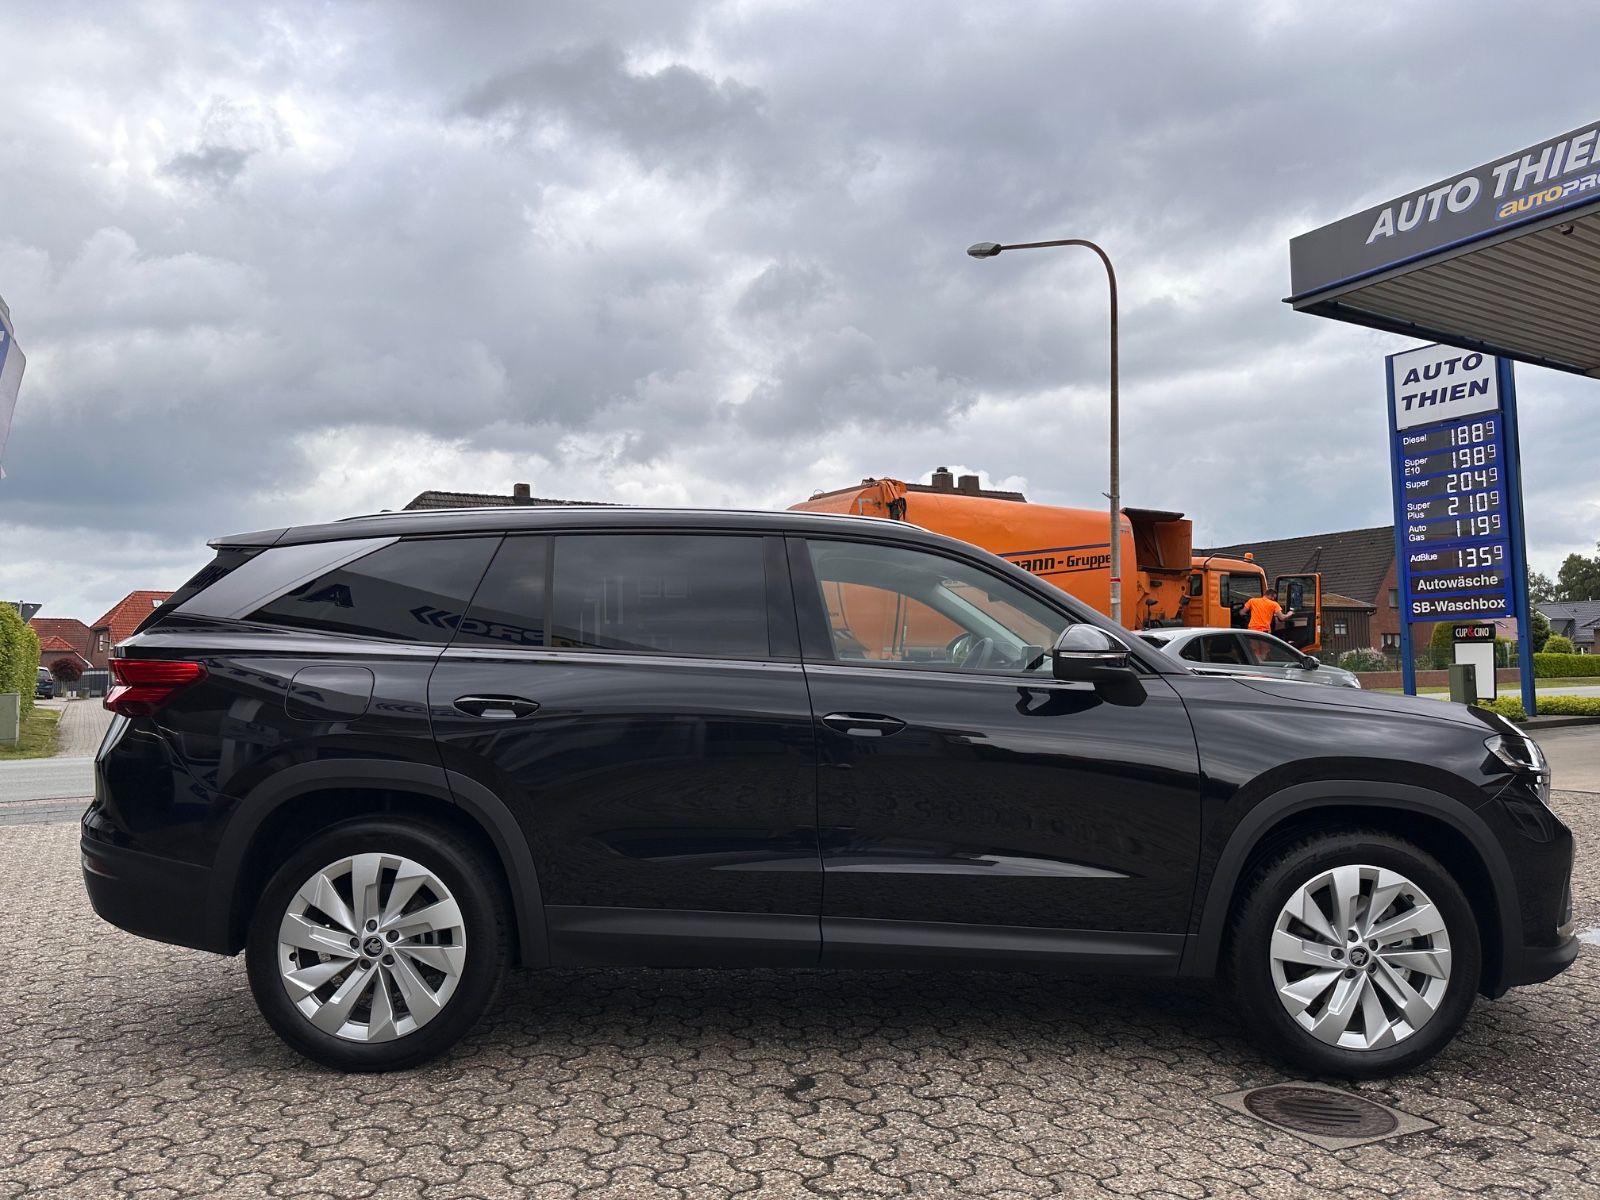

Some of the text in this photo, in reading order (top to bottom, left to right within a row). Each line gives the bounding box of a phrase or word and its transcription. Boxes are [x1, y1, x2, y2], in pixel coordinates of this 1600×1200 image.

[1365, 129, 1600, 245] AUTO THIE
[1402, 352, 1483, 386] AUTO
[1401, 377, 1489, 411] THIEN
[1403, 434, 1427, 445] Diesel
[1404, 457, 1428, 468] Super
[1405, 467, 1420, 476] E10
[1406, 479, 1429, 490] Super
[1407, 501, 1430, 512] Super
[1407, 512, 1425, 520] Plus
[1408, 524, 1427, 533] Auto
[1066, 554, 1111, 569] Gruppe
[1410, 552, 1438, 563] AdBlue
[1417, 574, 1499, 591] Autowäsche
[1412, 598, 1506, 614] SB-Waschbox
